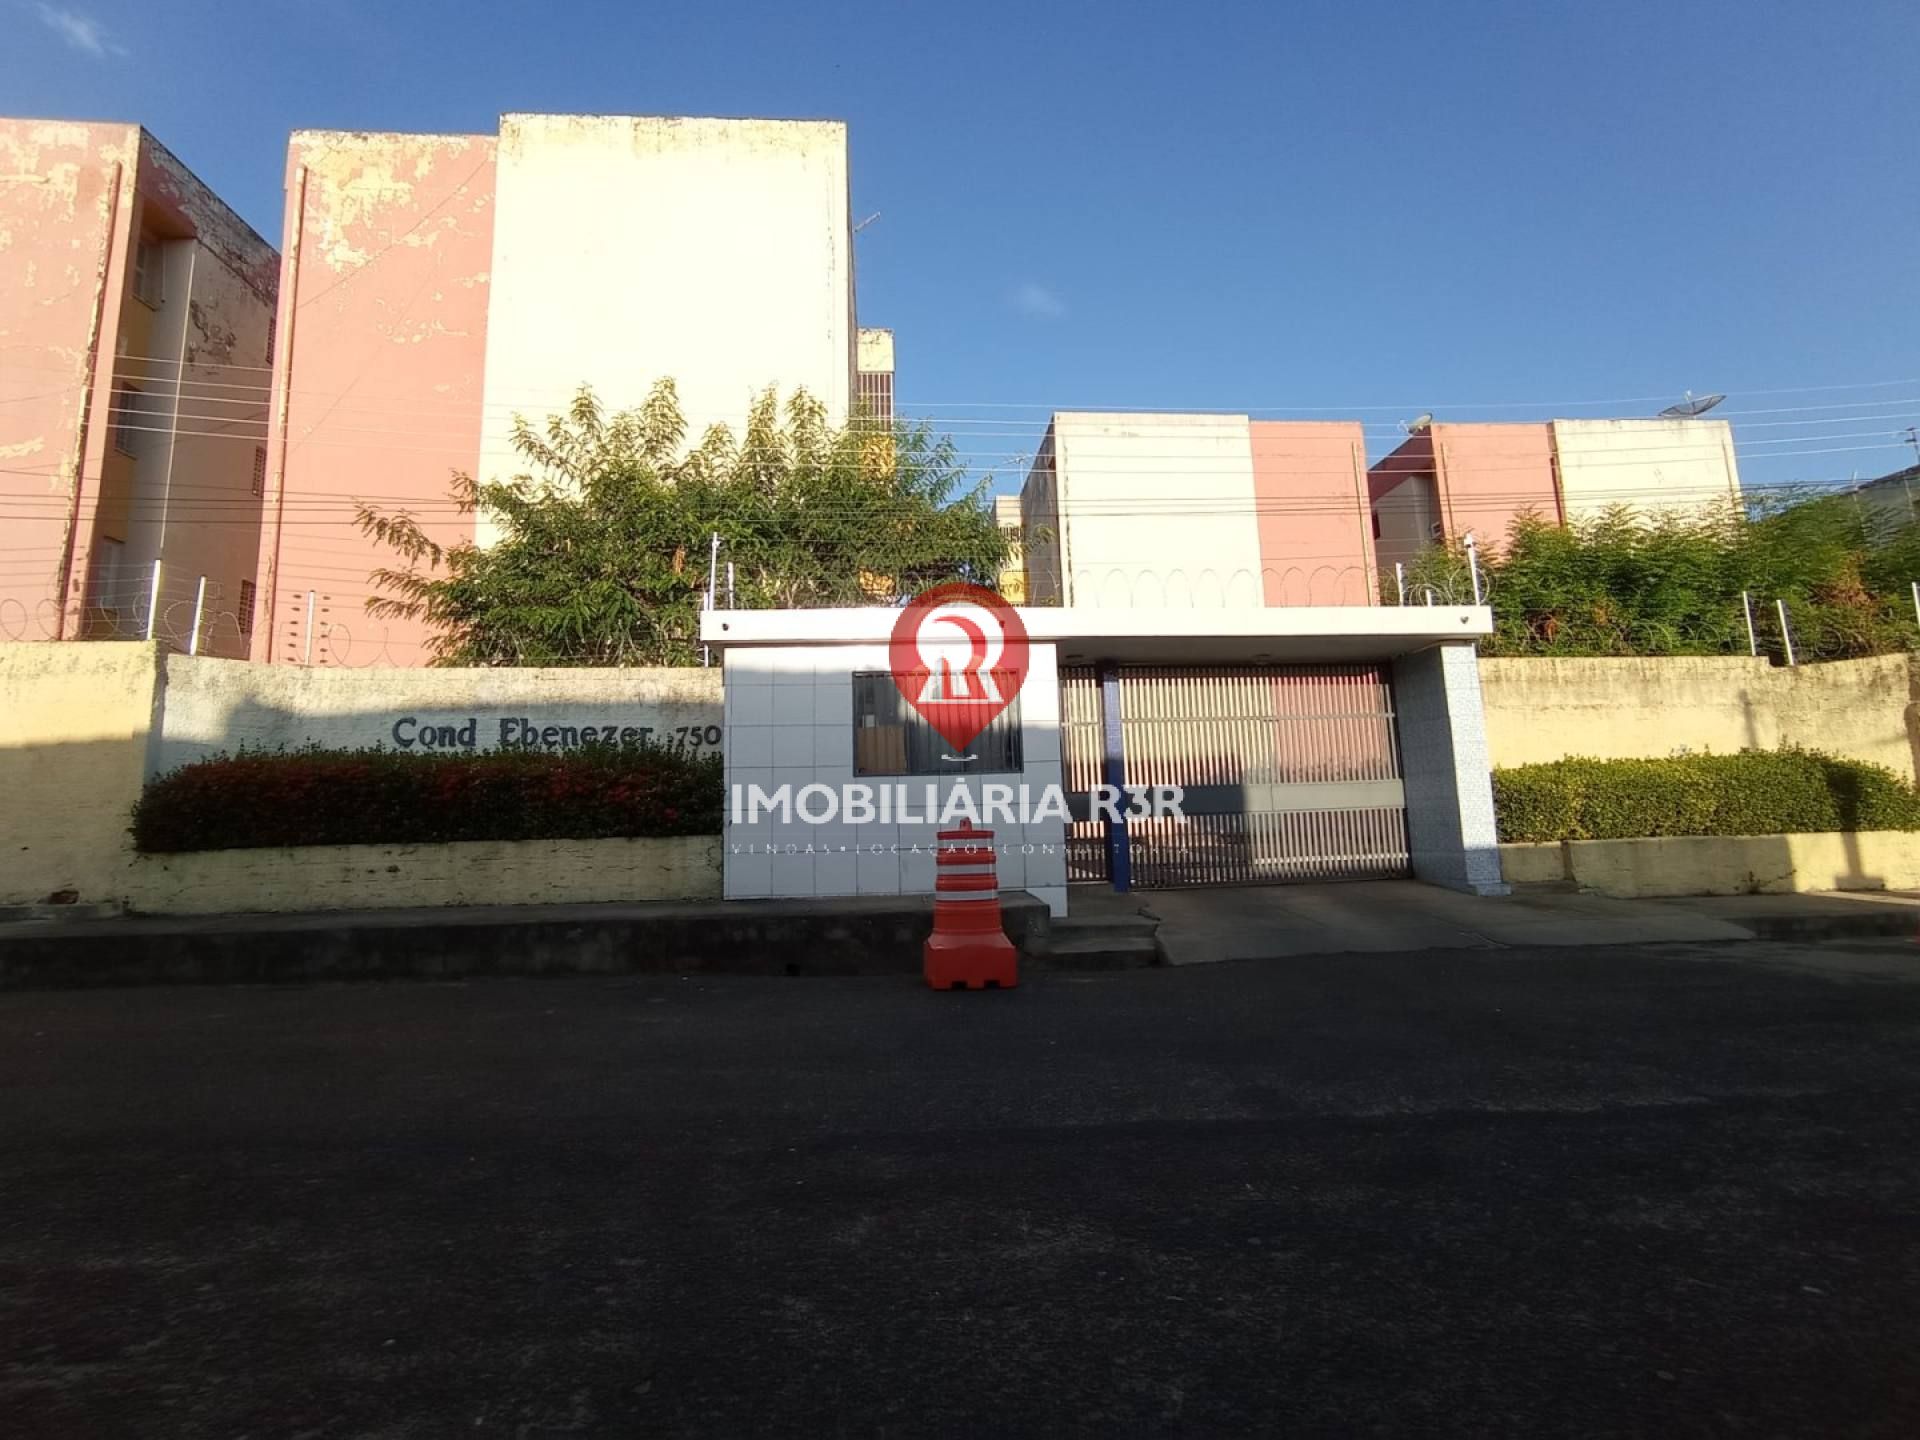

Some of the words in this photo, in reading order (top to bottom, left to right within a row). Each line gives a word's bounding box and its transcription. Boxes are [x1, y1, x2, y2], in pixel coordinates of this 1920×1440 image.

[392, 717, 477, 748] Cond
[497, 717, 654, 749] Ebenezer
[676, 725, 722, 748] 750
